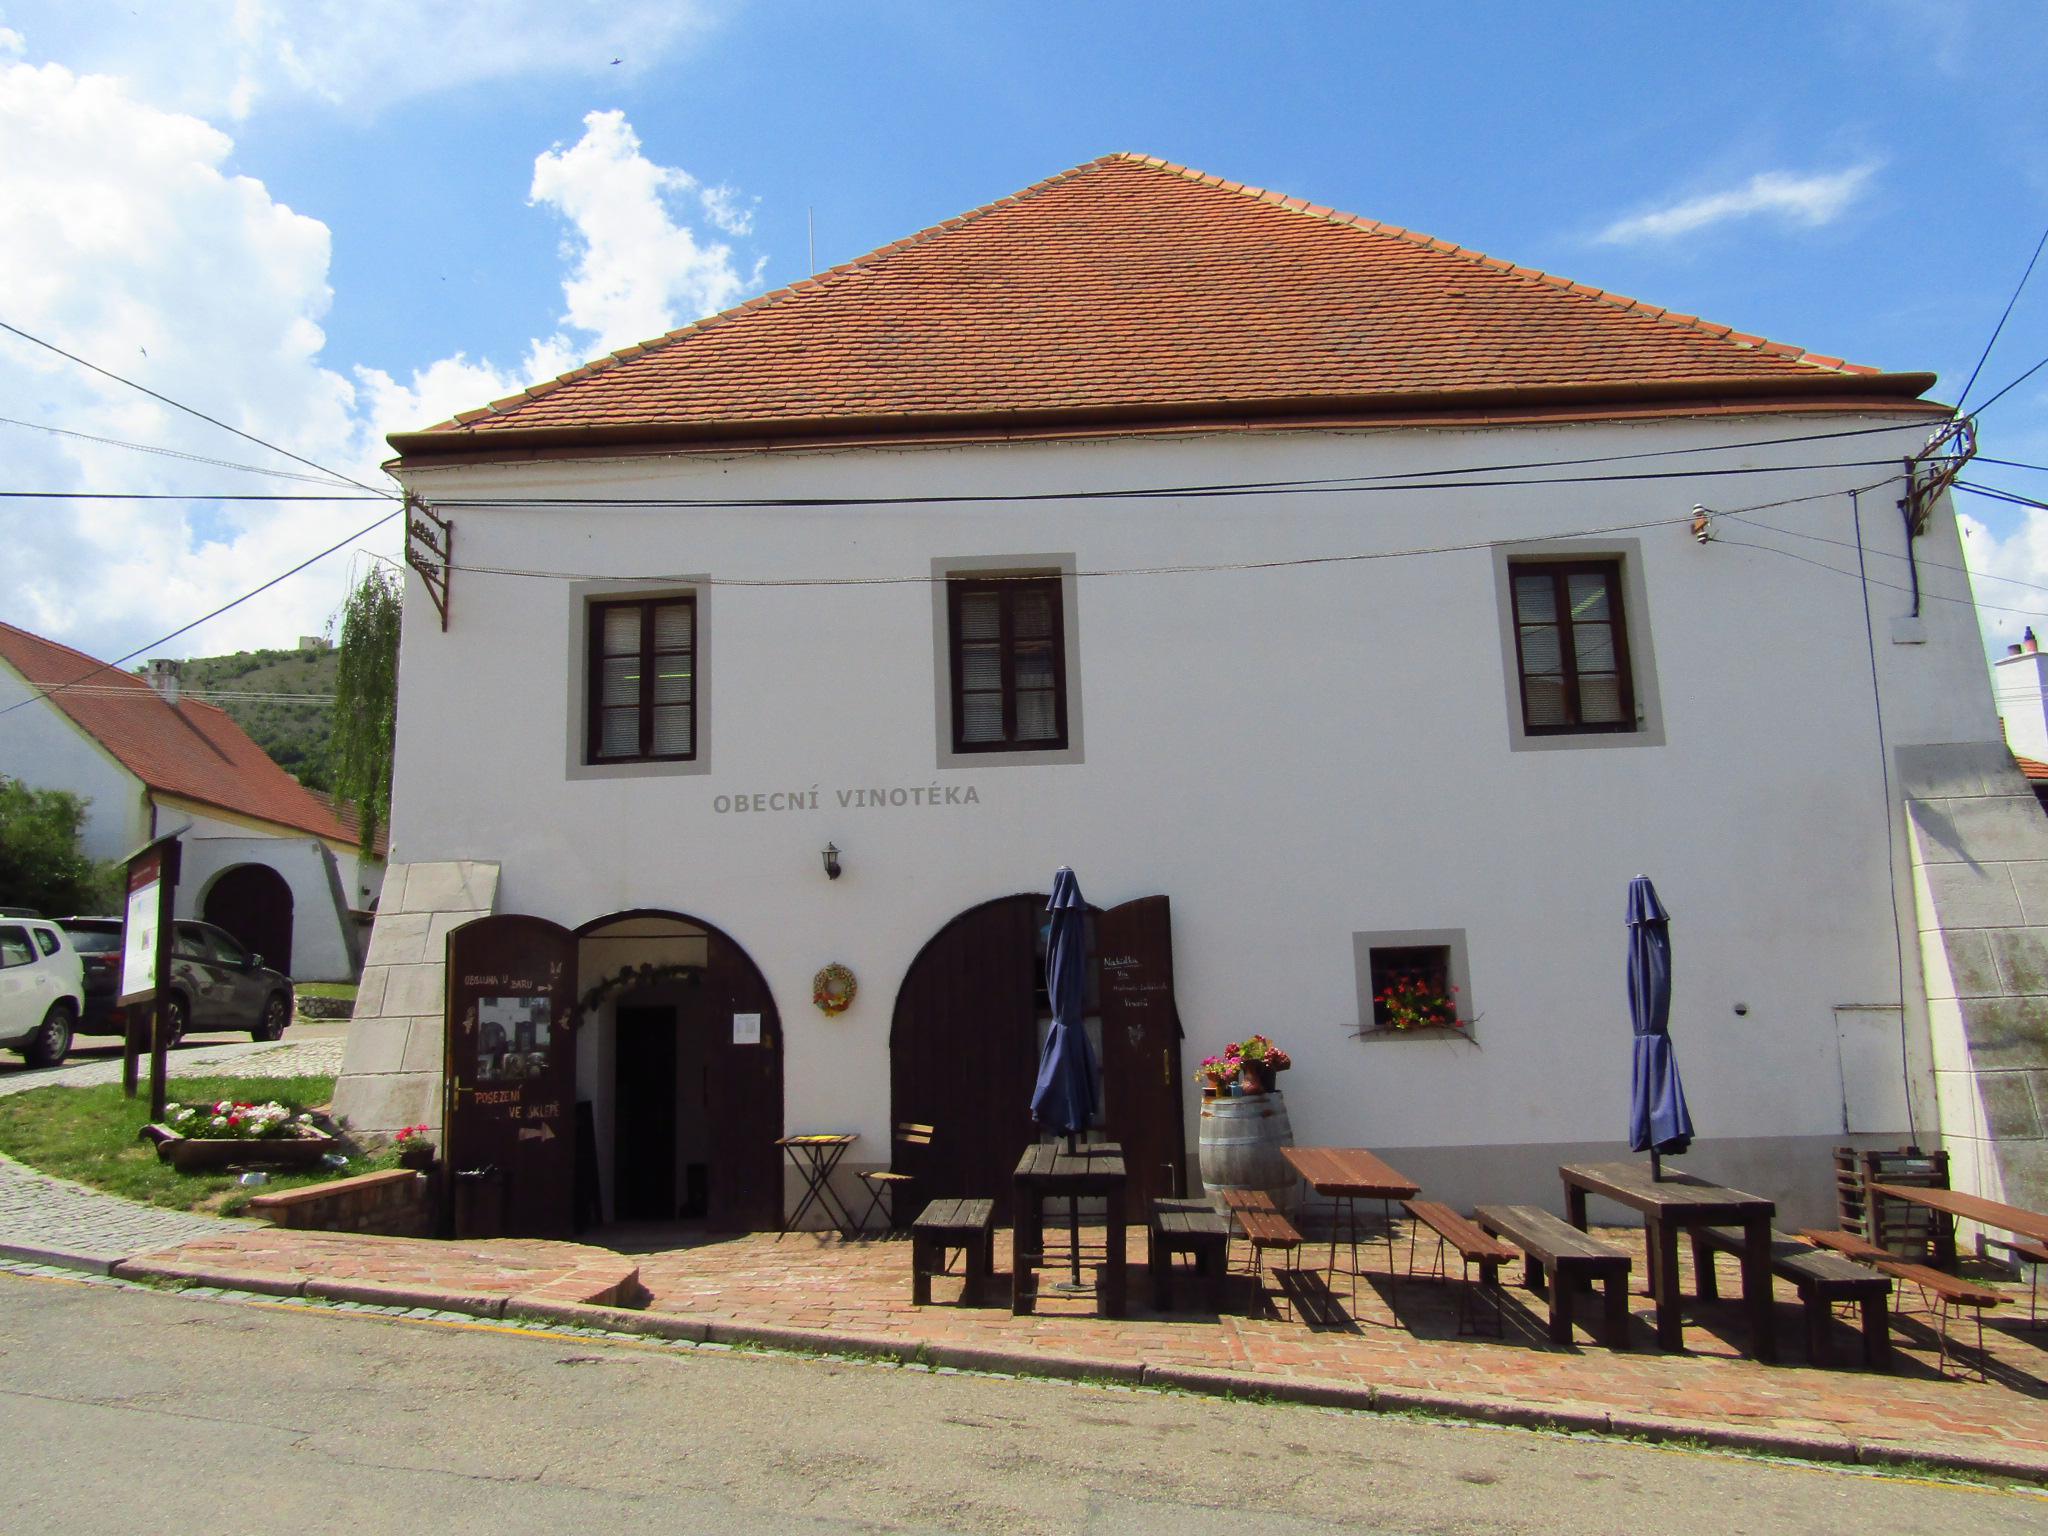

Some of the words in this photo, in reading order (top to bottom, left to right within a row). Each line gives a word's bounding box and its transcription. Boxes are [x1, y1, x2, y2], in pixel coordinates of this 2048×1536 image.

[713, 783, 819, 814] OBECNÍ
[836, 781, 981, 809] VINOTÉKA
[502, 974, 509, 984] U
[509, 1105, 522, 1119] VE
